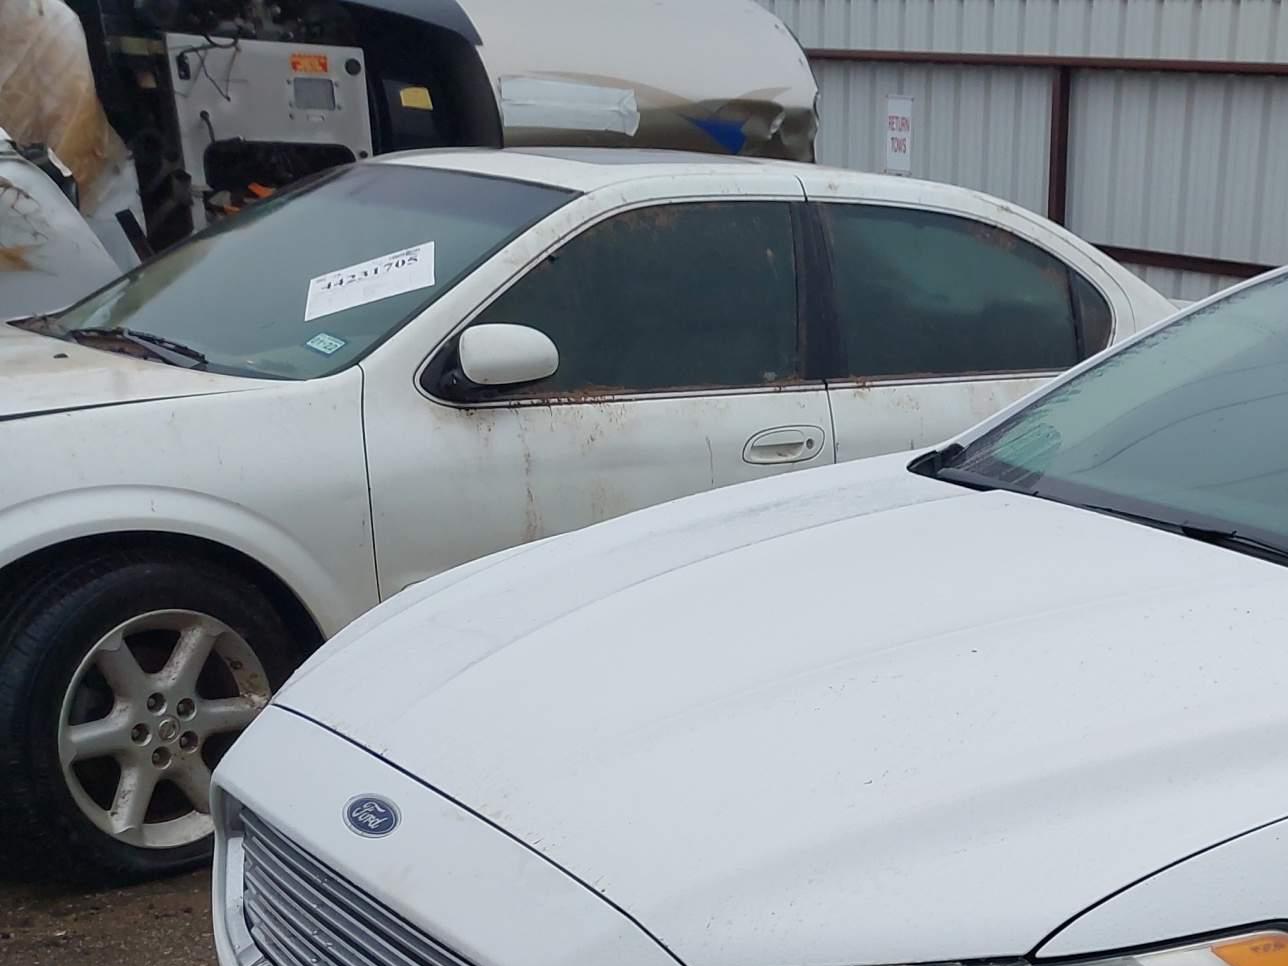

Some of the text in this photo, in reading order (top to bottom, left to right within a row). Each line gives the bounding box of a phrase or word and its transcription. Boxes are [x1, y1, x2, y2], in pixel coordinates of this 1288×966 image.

[888, 115, 911, 132] RETURN
[890, 136, 907, 154] TOWS
[352, 801, 388, 829] Ford
